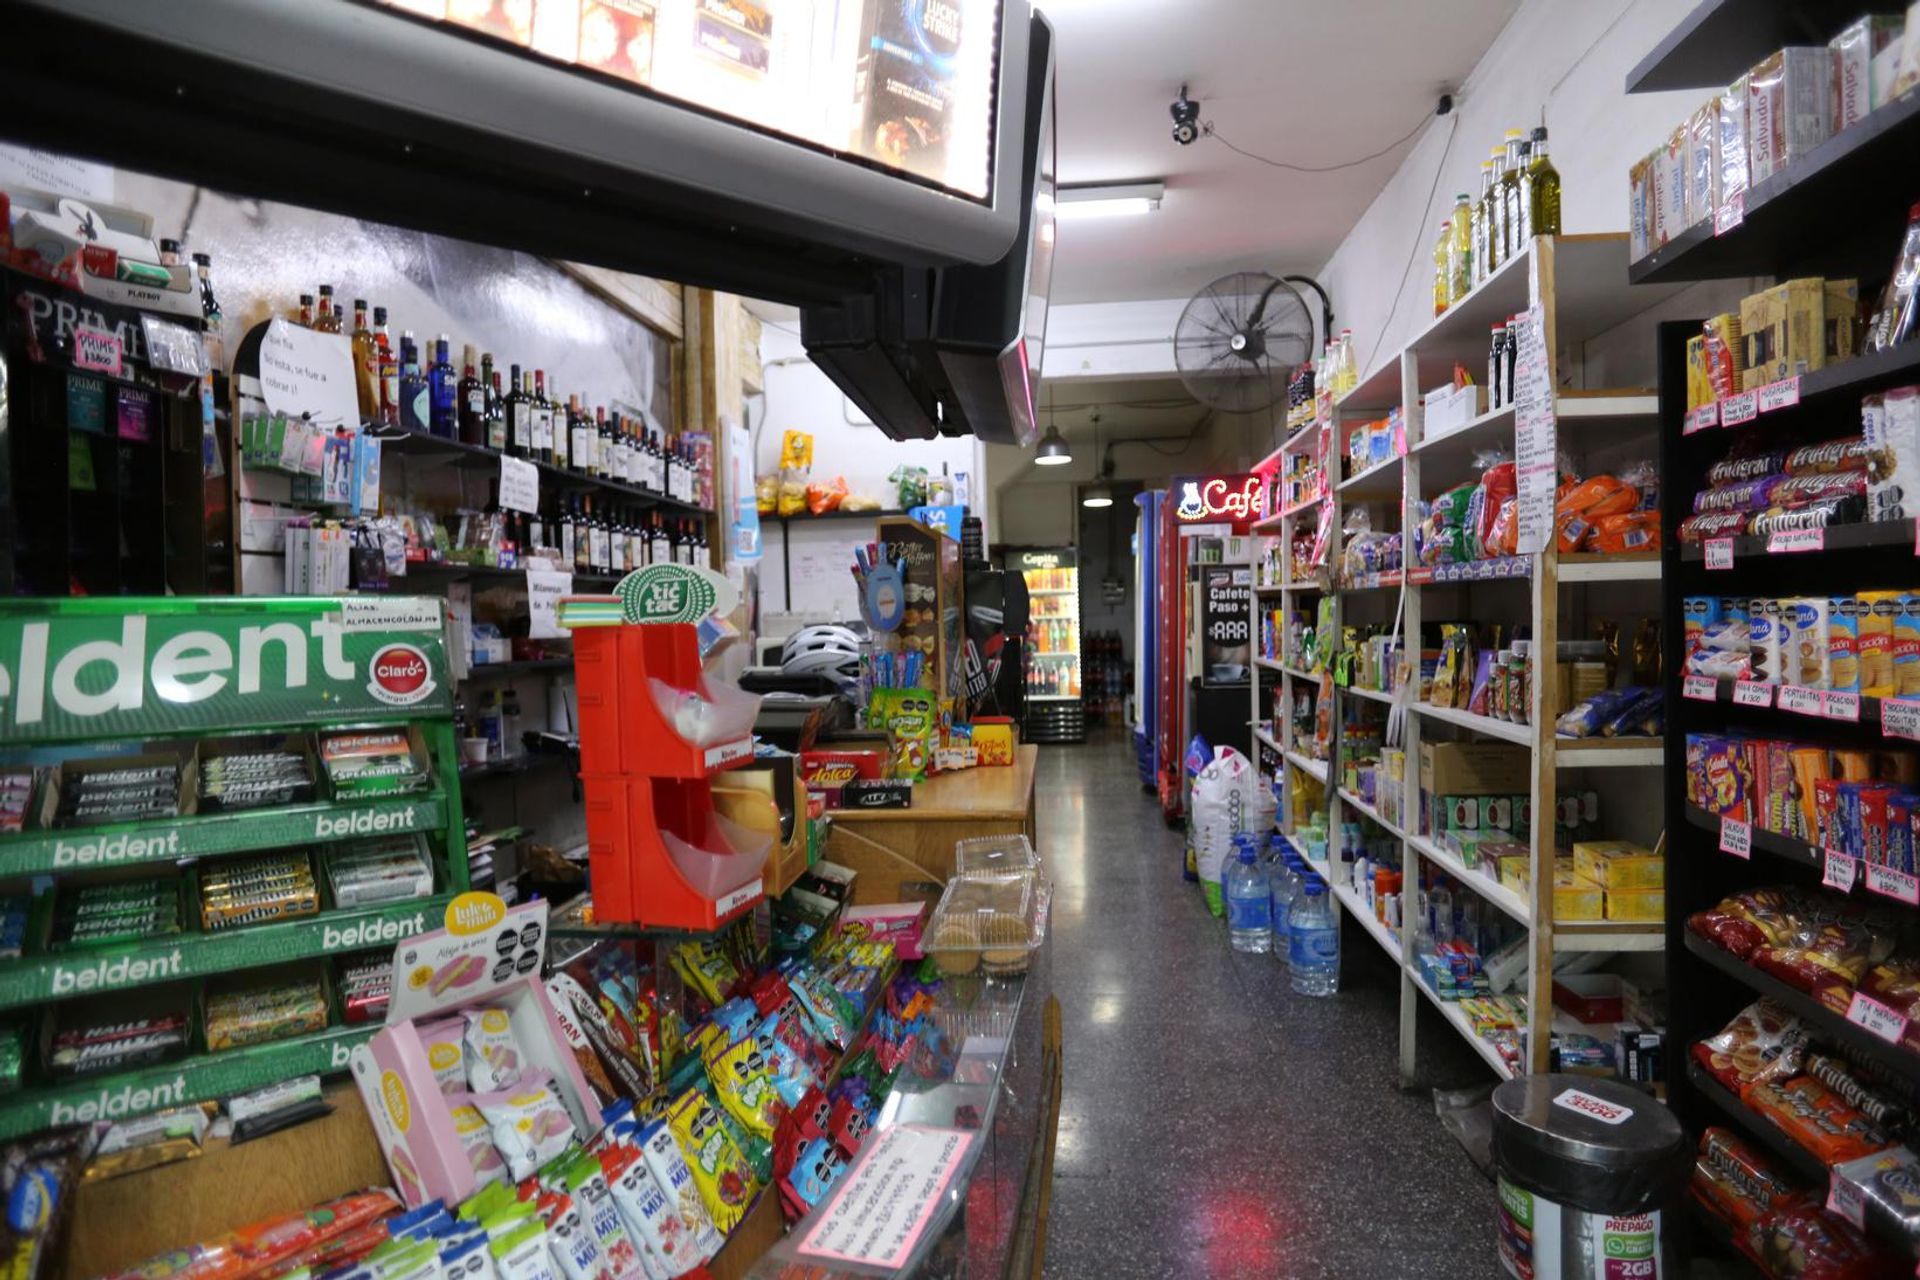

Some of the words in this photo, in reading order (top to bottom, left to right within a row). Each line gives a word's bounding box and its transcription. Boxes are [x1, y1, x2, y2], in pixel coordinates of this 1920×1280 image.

[922, 15, 959, 43] STRIKE
[1756, 94, 1768, 164] Salvado
[128, 289, 161, 301] PLAYBOY
[1203, 477, 1262, 519] Café
[652, 582, 680, 601] tic
[1210, 587, 1250, 600] Cafete
[645, 598, 680, 615] tac
[1209, 601, 1238, 613] Paso
[0, 611, 355, 726] ldent
[377, 661, 421, 679] Claro
[81, 768, 158, 784] beldent
[315, 806, 415, 838] beldent
[53, 830, 180, 867] beldent
[207, 904, 282, 931] mentho
[322, 912, 425, 949] beldent
[51, 949, 183, 994] beldent
[84, 1019, 149, 1039] HALLS
[50, 1075, 186, 1124] beldent
[1566, 1098, 1617, 1120] 3500
[670, 1165, 689, 1190] MIX
[641, 1191, 665, 1220] MIX
[595, 1215, 622, 1238] MIX
[1604, 1219, 1654, 1233] PREPAGO
[575, 1242, 600, 1271] MIX
[1620, 1261, 1653, 1277] 2GB
